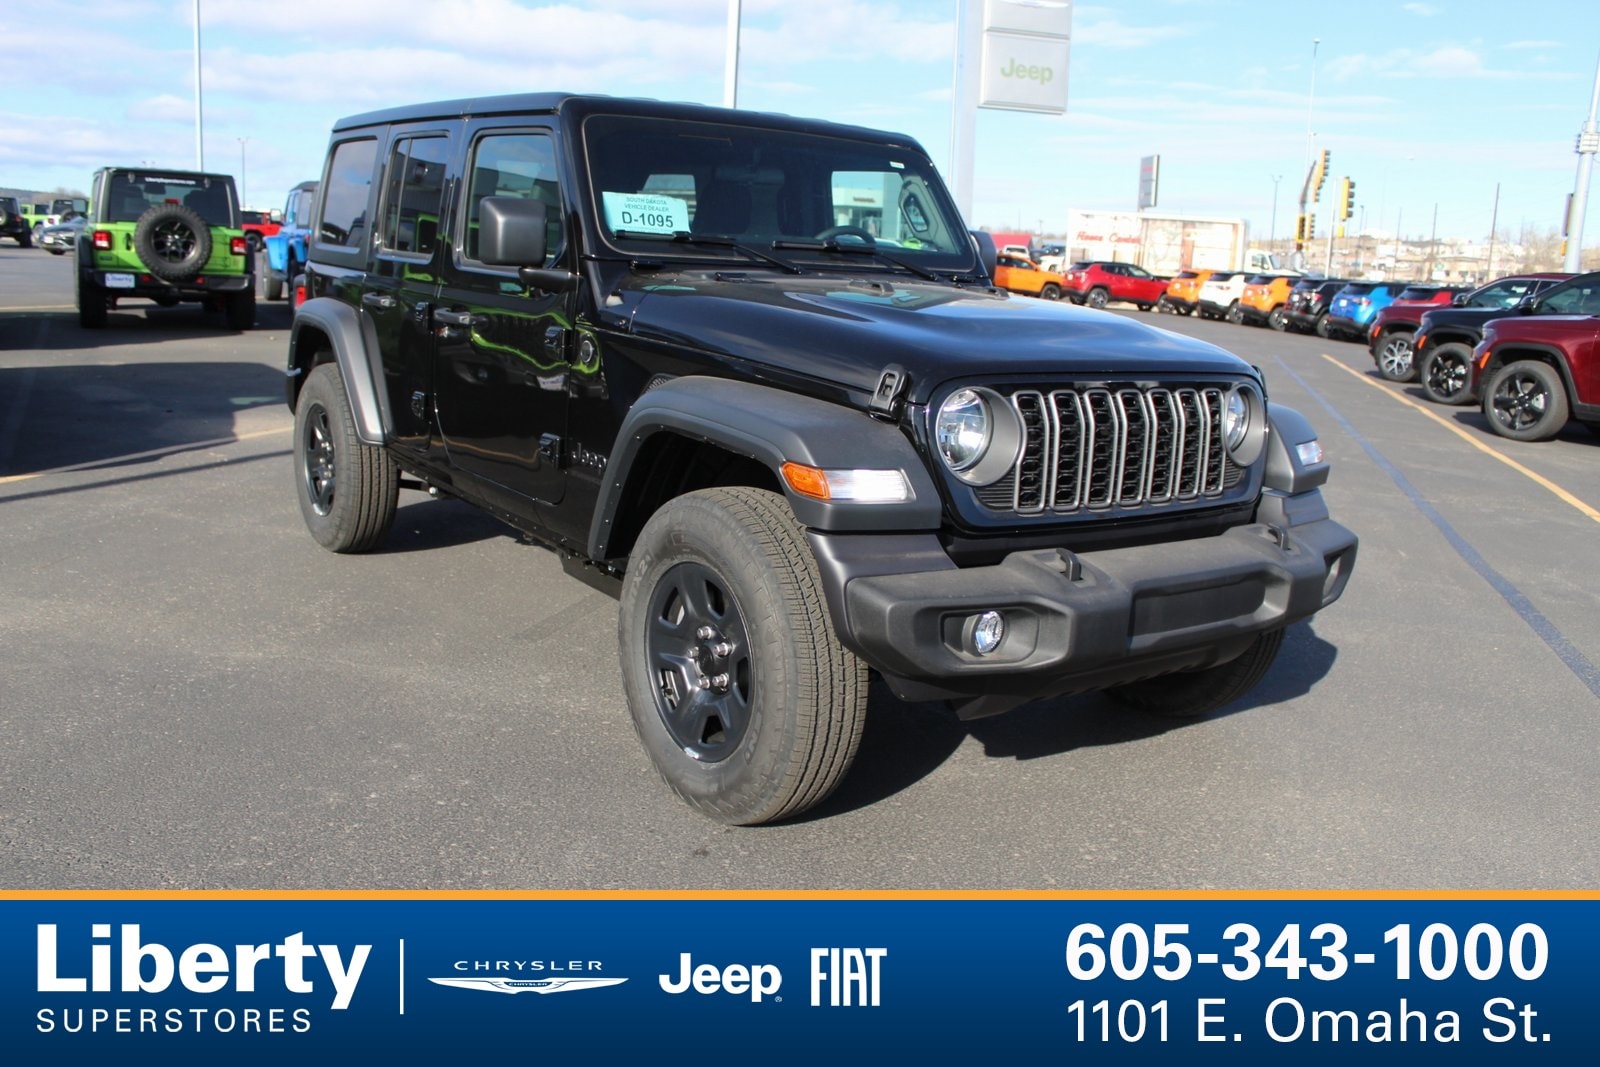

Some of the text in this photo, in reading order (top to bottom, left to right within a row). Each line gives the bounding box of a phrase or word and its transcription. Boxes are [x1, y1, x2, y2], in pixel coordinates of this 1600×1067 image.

[1000, 57, 1054, 85] Jeep
[647, 204, 670, 212] DEALER
[621, 211, 674, 228] D-1095
